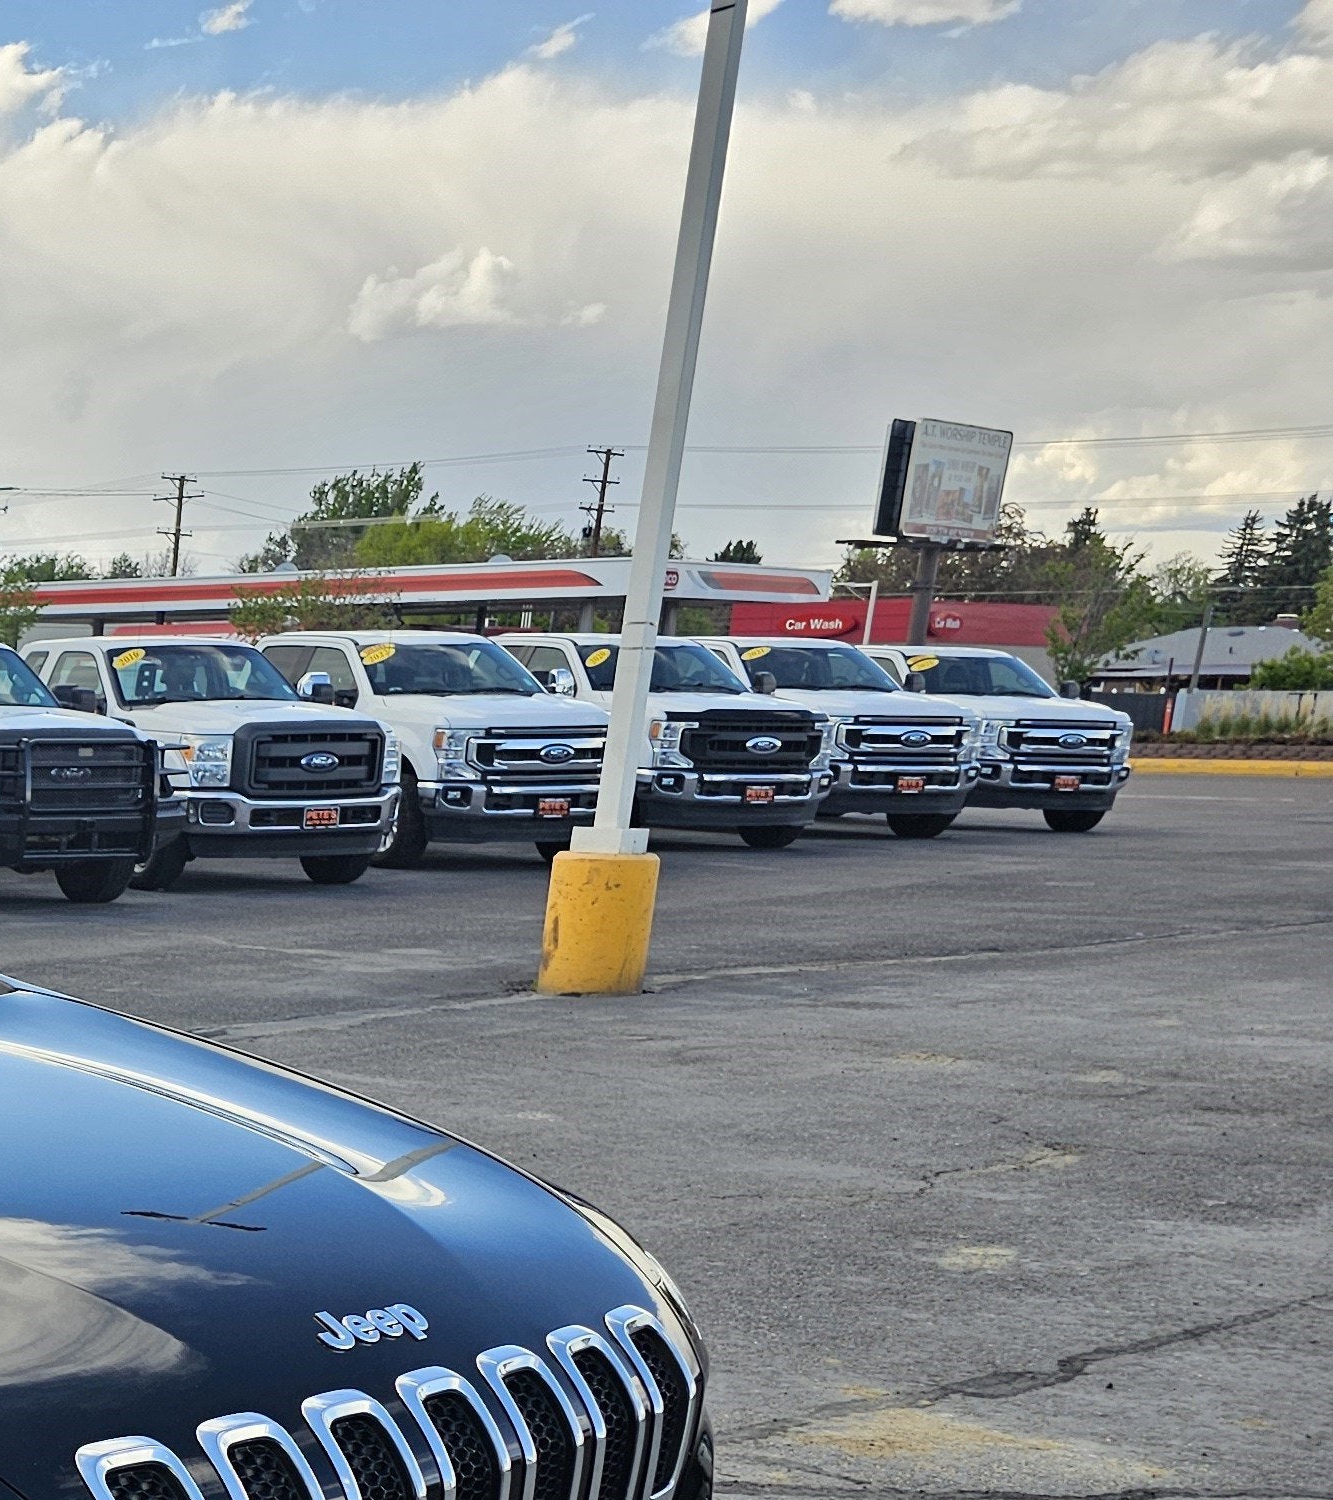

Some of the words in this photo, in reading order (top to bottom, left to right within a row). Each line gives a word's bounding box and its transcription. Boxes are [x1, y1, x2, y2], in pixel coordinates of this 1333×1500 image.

[785, 619, 806, 631] Car
[810, 618, 843, 630] Wash
[119, 651, 139, 666] 2016
[313, 1303, 429, 1351] Jeep
